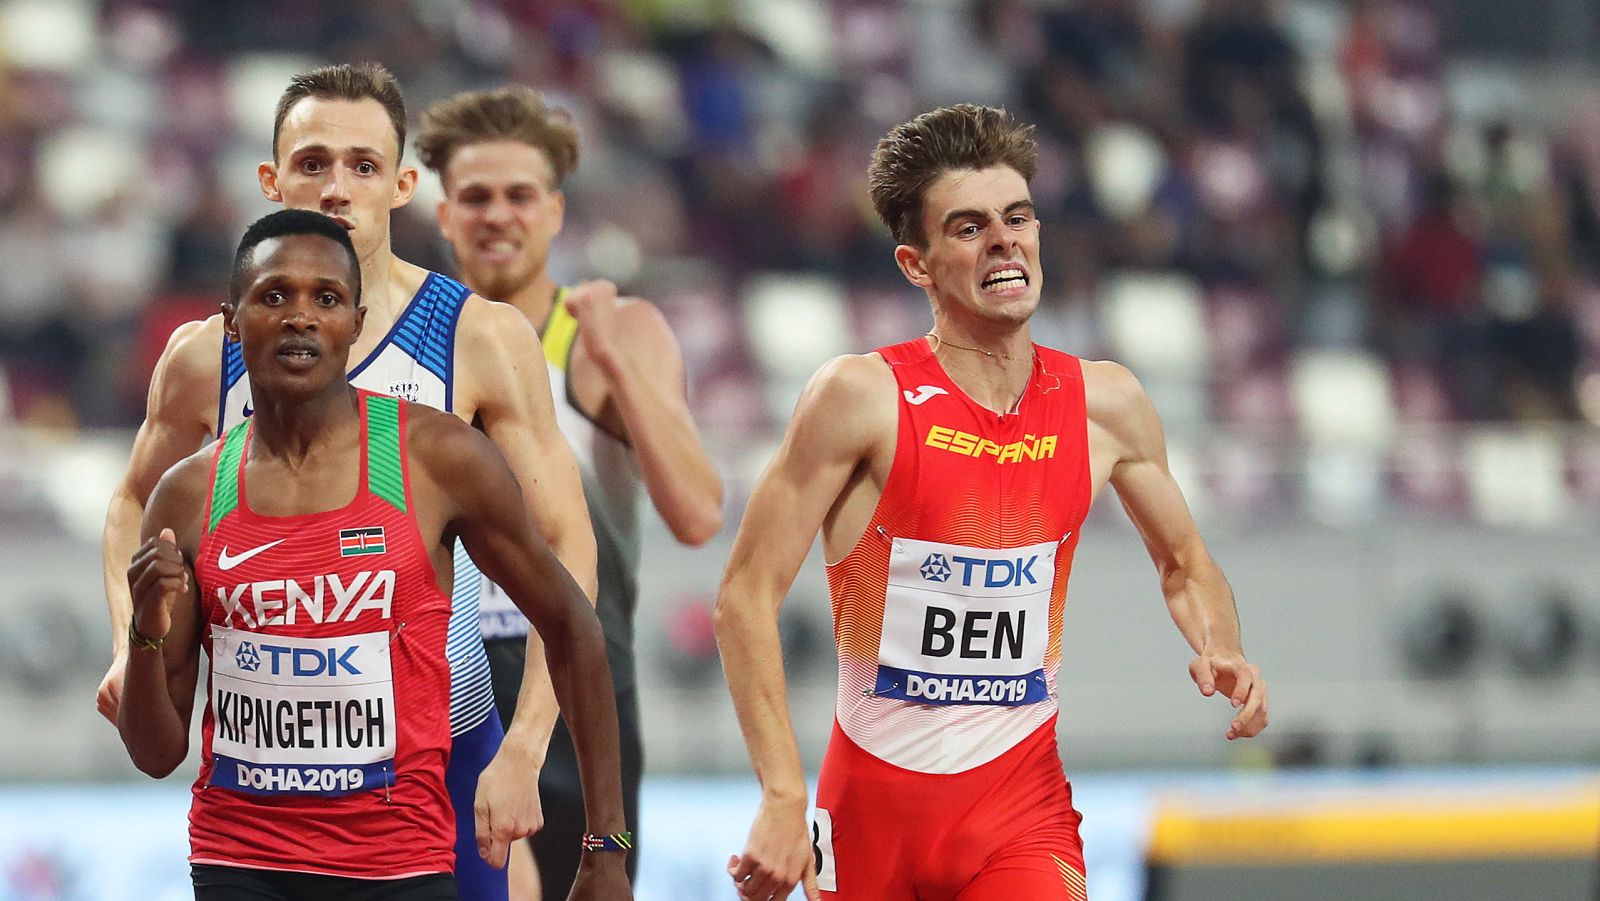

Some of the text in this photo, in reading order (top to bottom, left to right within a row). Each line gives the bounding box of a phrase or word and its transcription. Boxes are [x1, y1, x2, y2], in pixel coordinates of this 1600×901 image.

[925, 425, 1057, 464] ESPAÑA
[952, 555, 1037, 587] TDK
[217, 570, 396, 629] KENYA
[921, 605, 1026, 659] BEN
[260, 645, 362, 677] TDK
[906, 675, 1027, 702] DOHA2019
[218, 689, 385, 749] KIPNGETICH
[237, 764, 364, 791] DOHA2019
